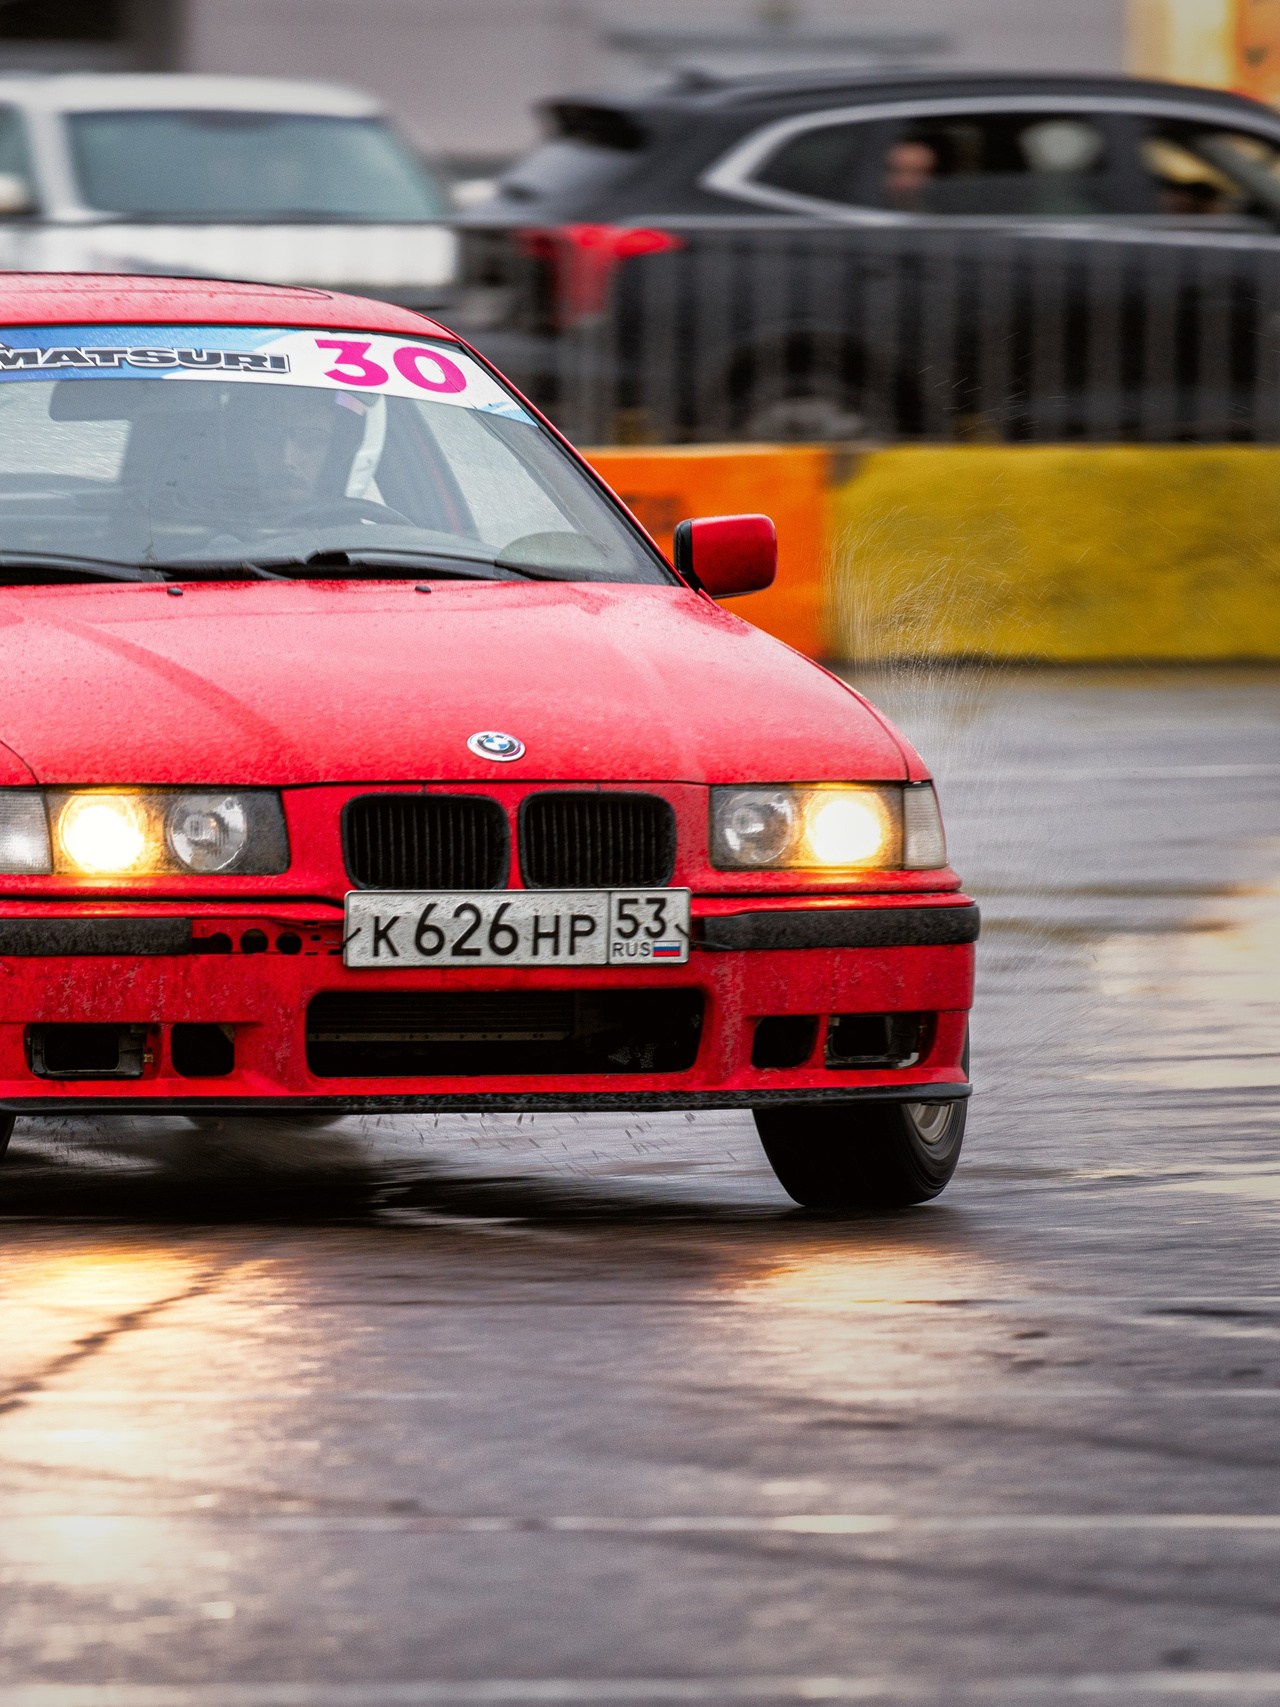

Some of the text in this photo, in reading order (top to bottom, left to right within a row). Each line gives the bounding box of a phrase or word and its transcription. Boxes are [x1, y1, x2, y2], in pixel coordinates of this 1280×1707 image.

[315, 338, 468, 394] 30
[615, 897, 669, 938] 53
[612, 942, 651, 957] RUS
